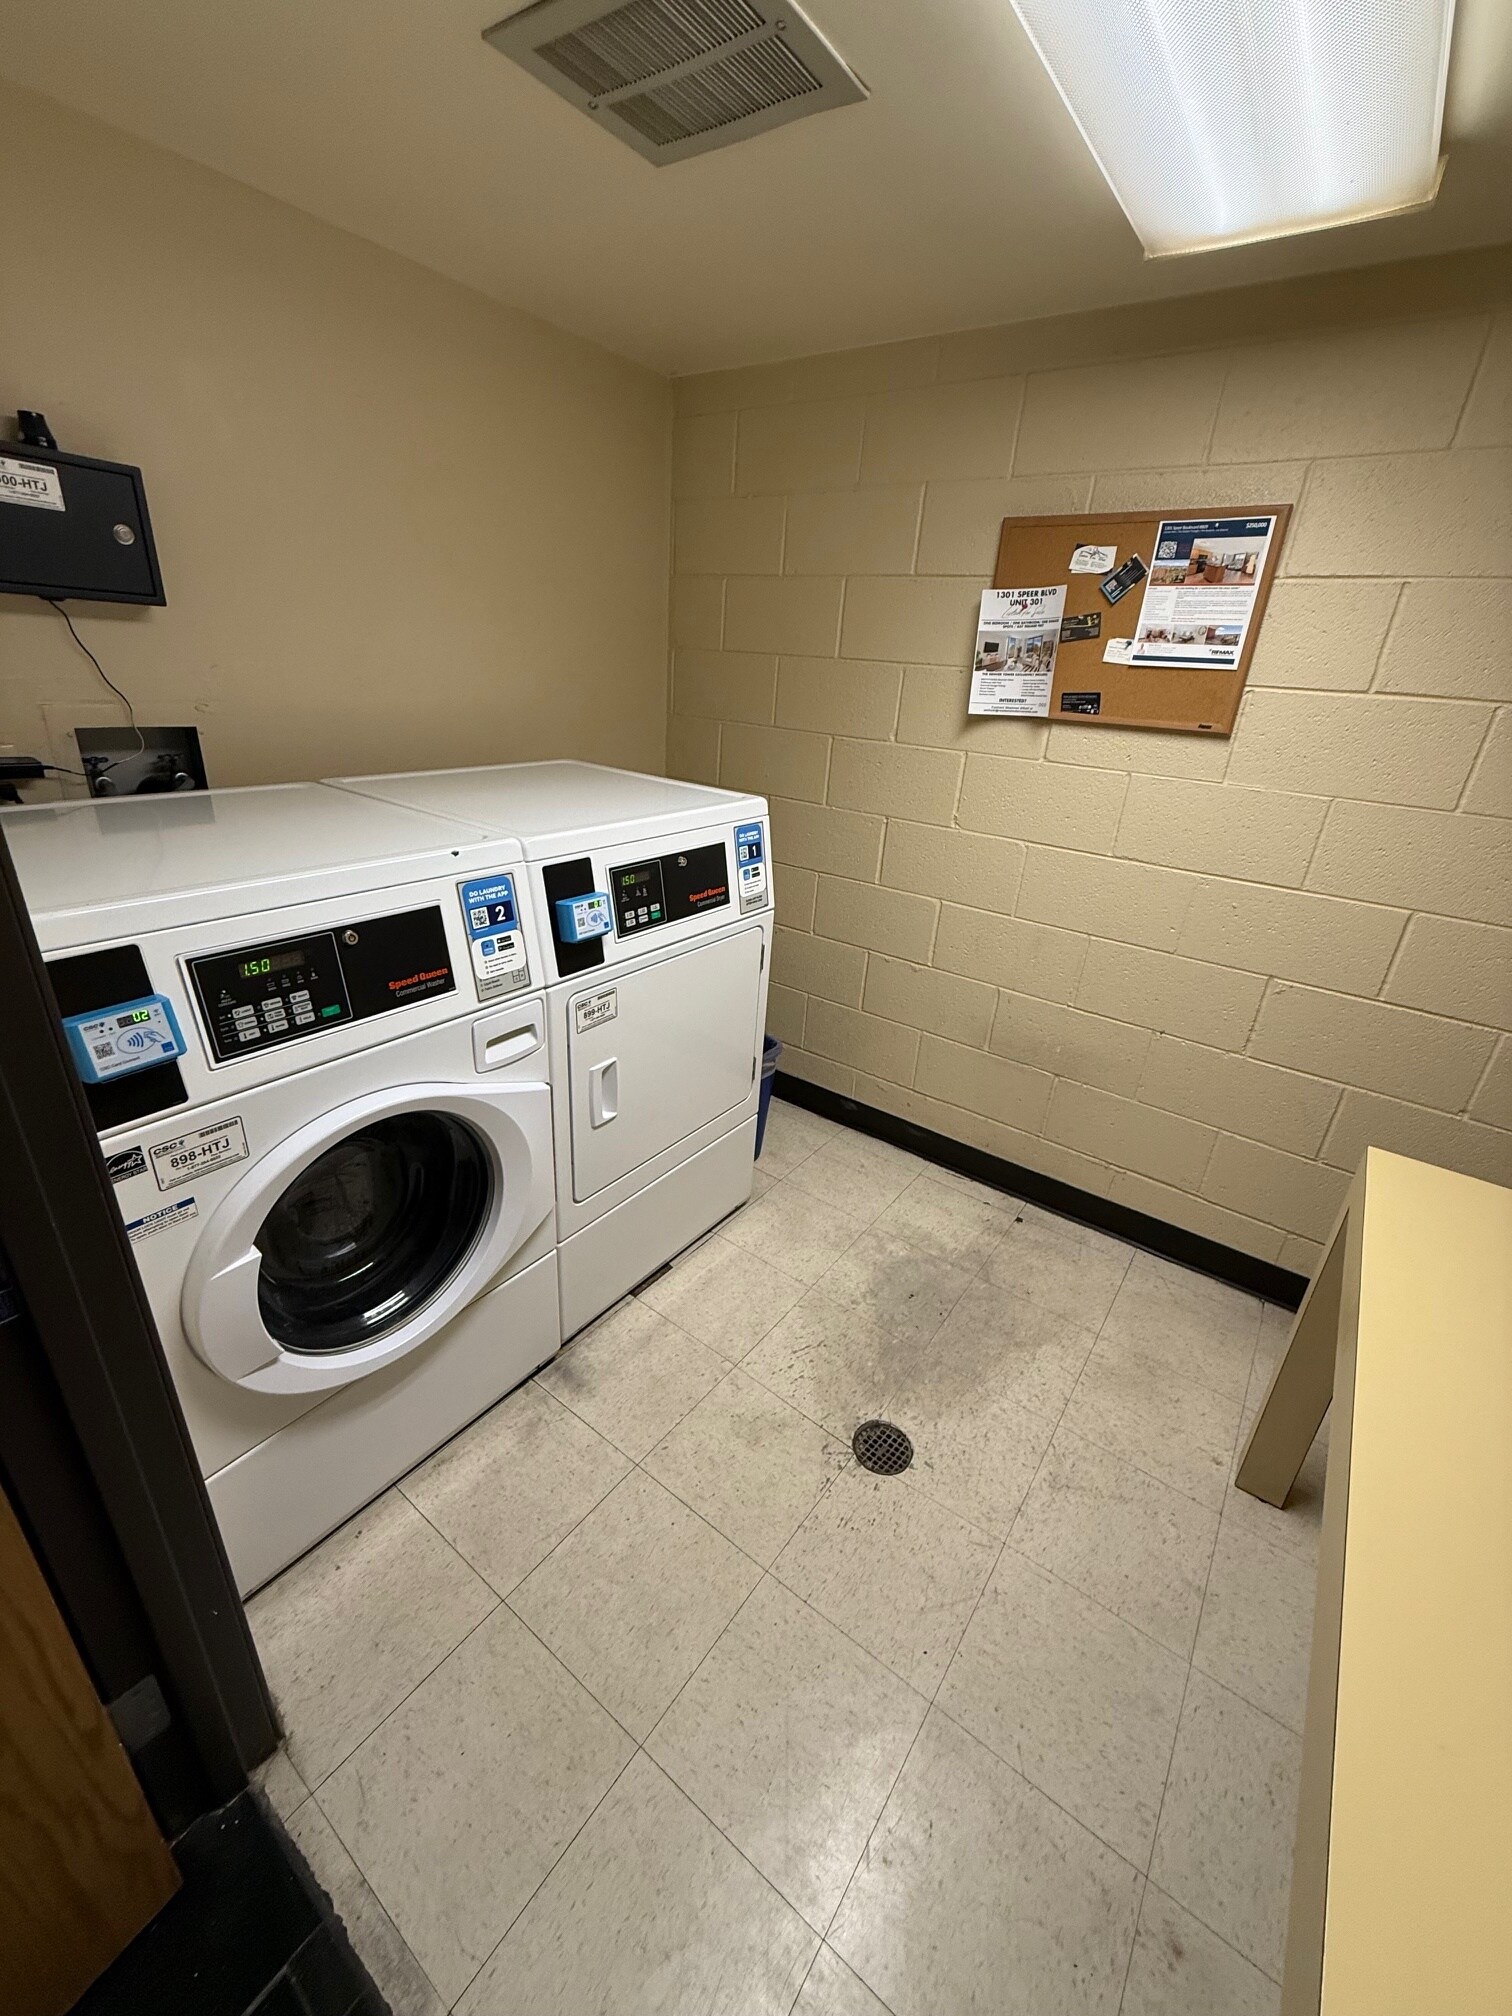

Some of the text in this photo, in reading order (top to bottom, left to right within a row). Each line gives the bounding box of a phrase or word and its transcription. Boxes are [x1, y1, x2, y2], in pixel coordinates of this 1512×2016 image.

[0, 474, 48, 492] 00-HTJ
[996, 588, 1057, 599] 1301 SPEER BLVD
[752, 844, 757, 857] 1
[468, 884, 506, 898] DO LAUNDRY
[468, 890, 509, 904] WITH THE APP
[689, 885, 726, 903] Speed Queen
[494, 905, 506, 922] 2
[388, 967, 449, 991] Speed Queen
[396, 977, 446, 998] Commercial Washer
[132, 1009, 149, 1023] 02
[153, 1142, 178, 1156] CSC
[170, 1138, 230, 1169] 898-HTJ
[142, 1204, 178, 1223] NOTICE
